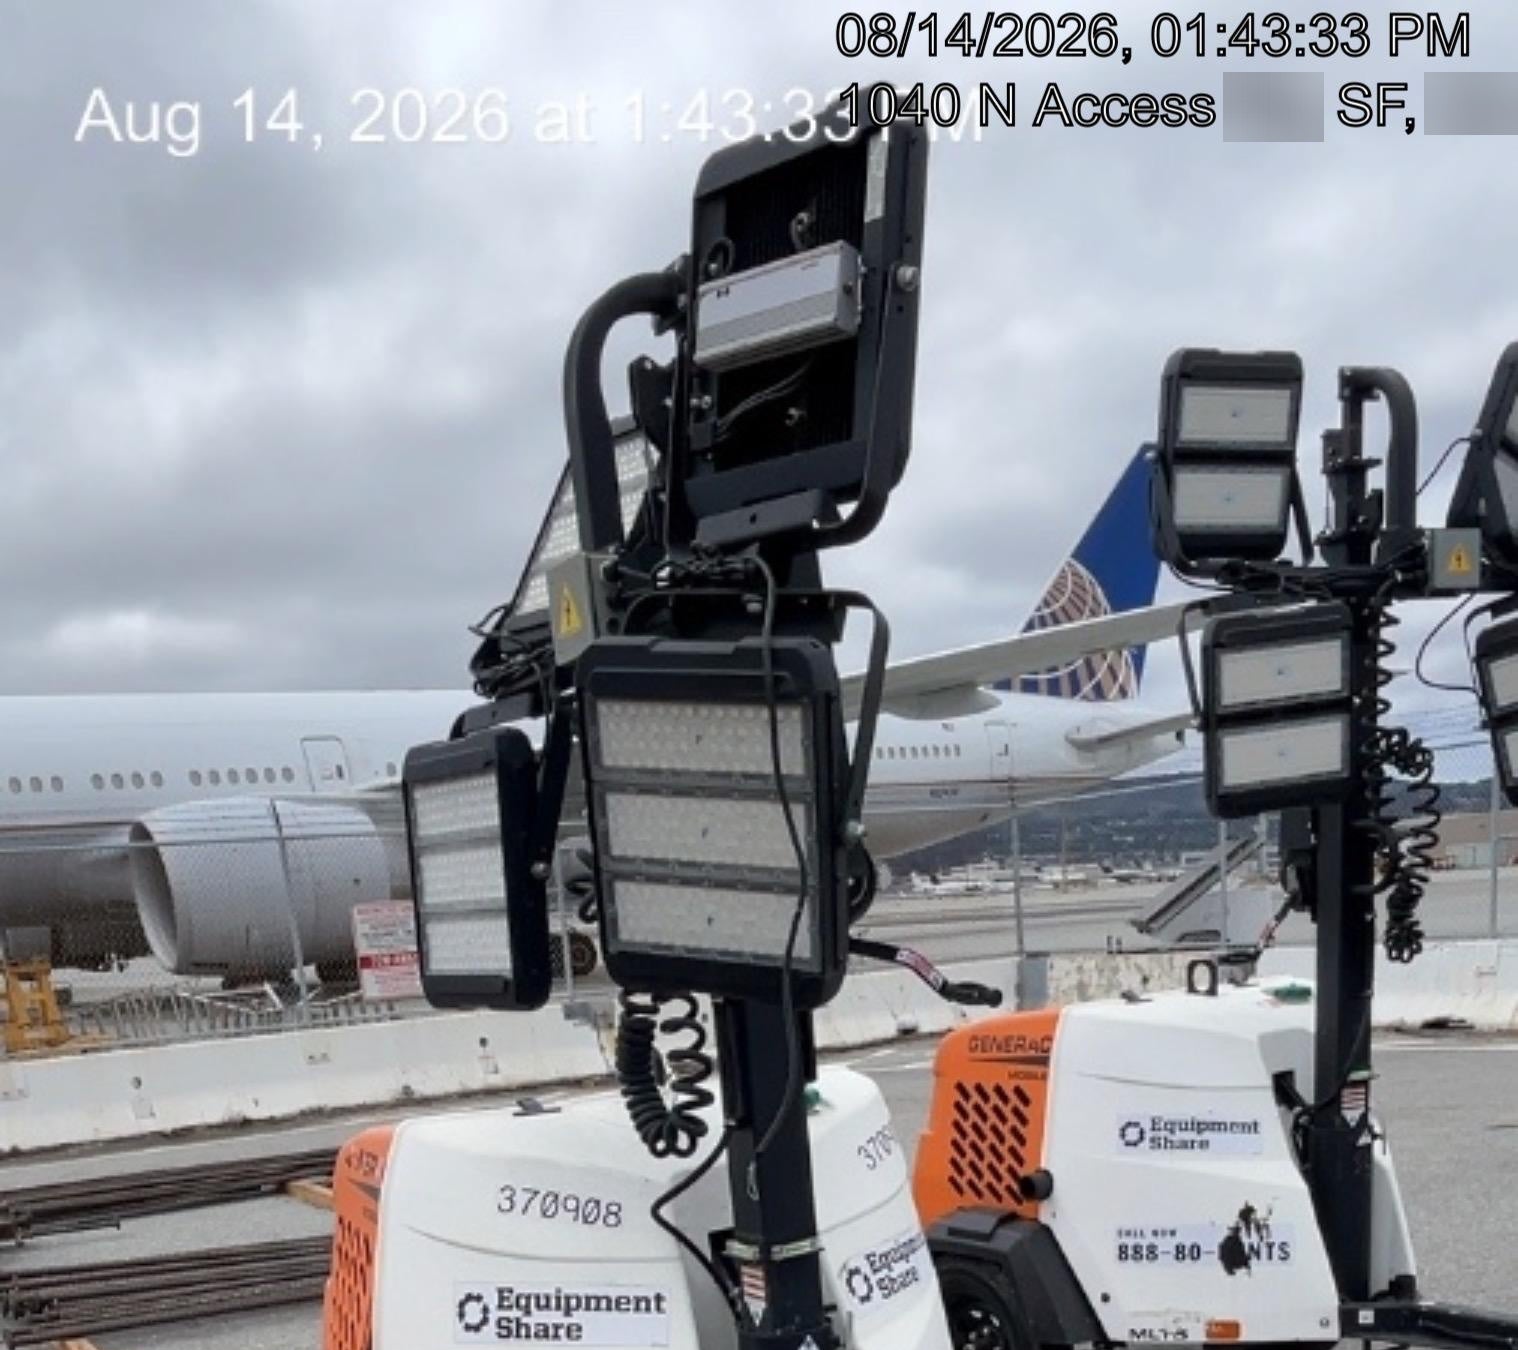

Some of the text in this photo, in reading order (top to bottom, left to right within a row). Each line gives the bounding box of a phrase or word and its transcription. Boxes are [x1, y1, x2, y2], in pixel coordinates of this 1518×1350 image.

[1150, 1116, 1261, 1135] Equipment
[1149, 1136, 1210, 1151] Share
[497, 1184, 622, 1229] 370908
[1117, 1242, 1291, 1263] 888-80-NTS
[495, 1286, 668, 1318] Equipment
[494, 1315, 584, 1342] Share
